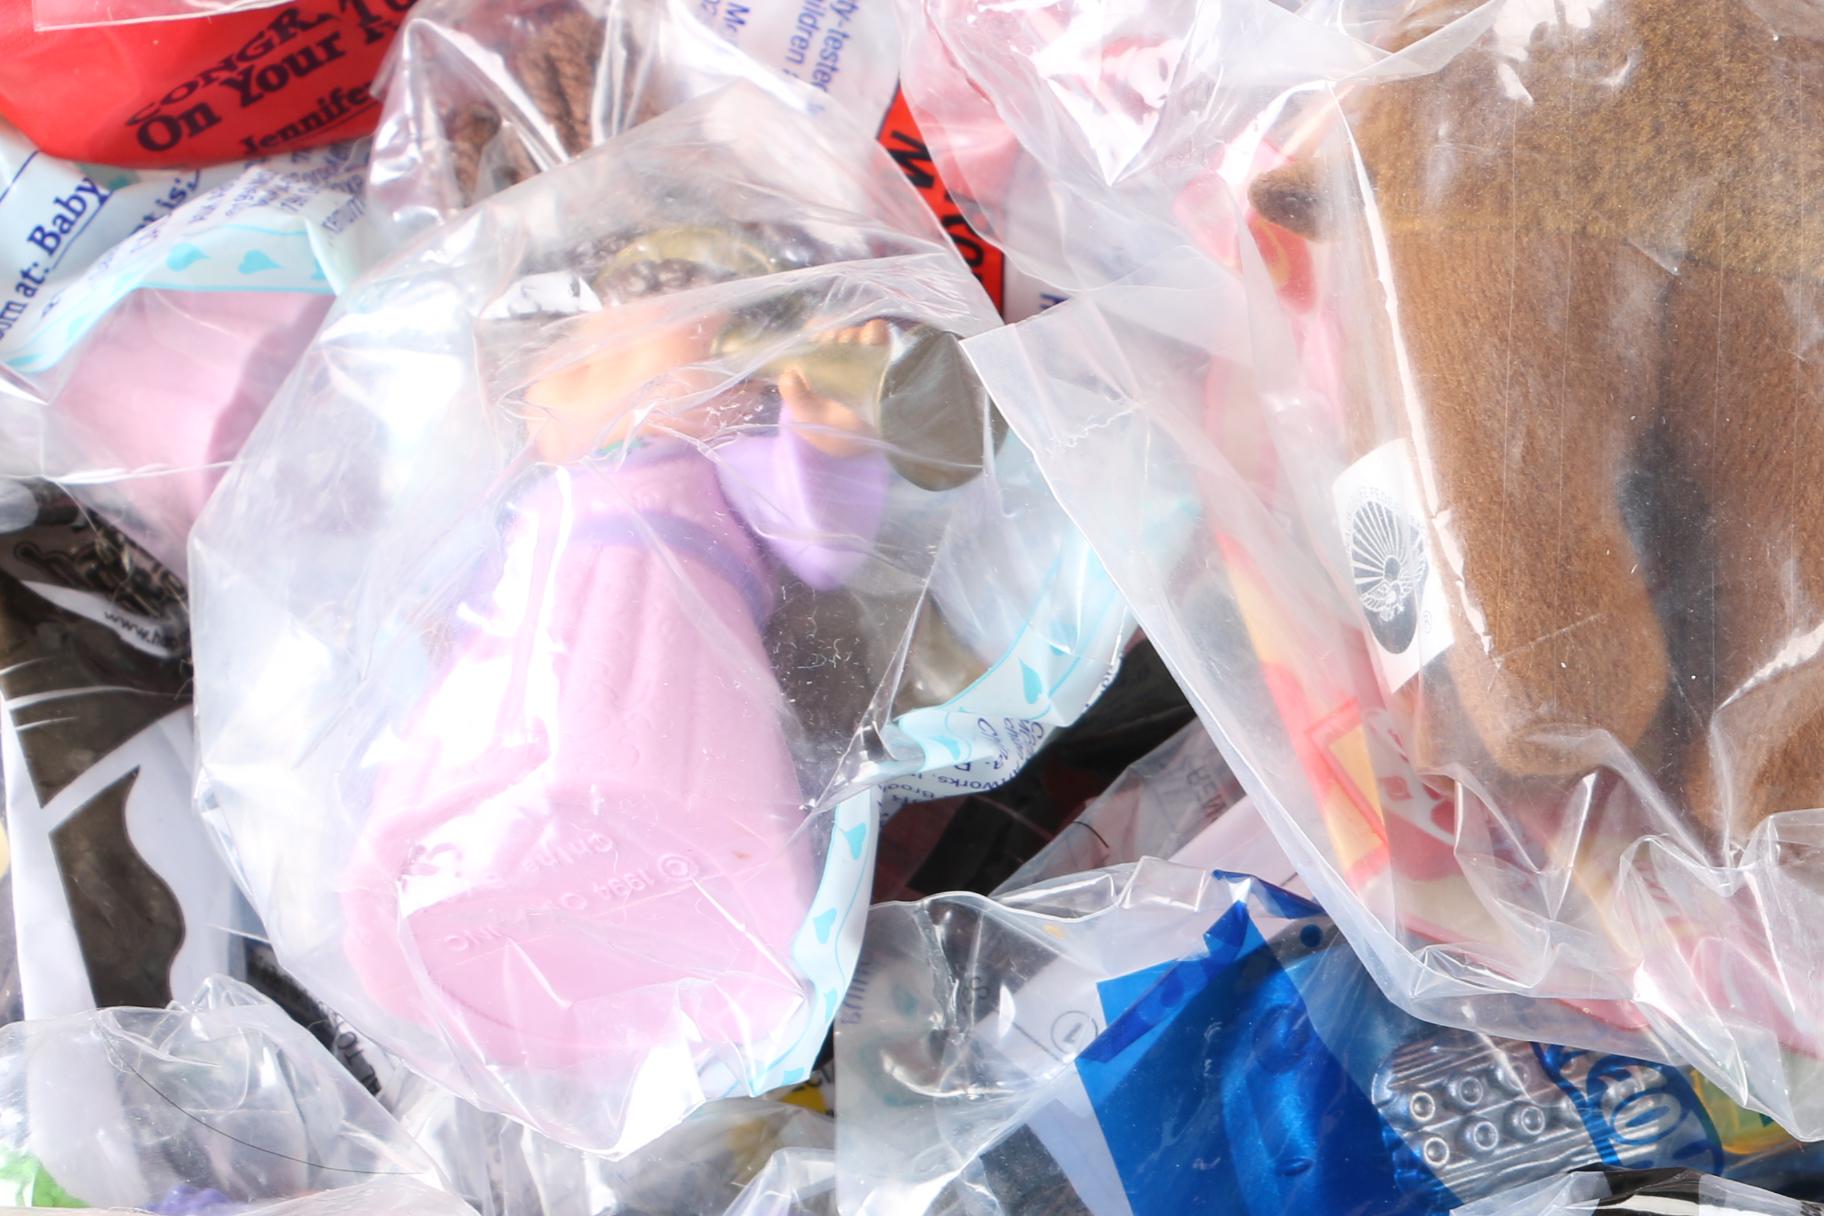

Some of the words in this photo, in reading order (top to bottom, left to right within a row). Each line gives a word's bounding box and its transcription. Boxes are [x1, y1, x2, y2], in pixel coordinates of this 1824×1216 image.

[136, 102, 223, 152] On
[221, 31, 346, 109] Your
[27, 177, 102, 256] Baby
